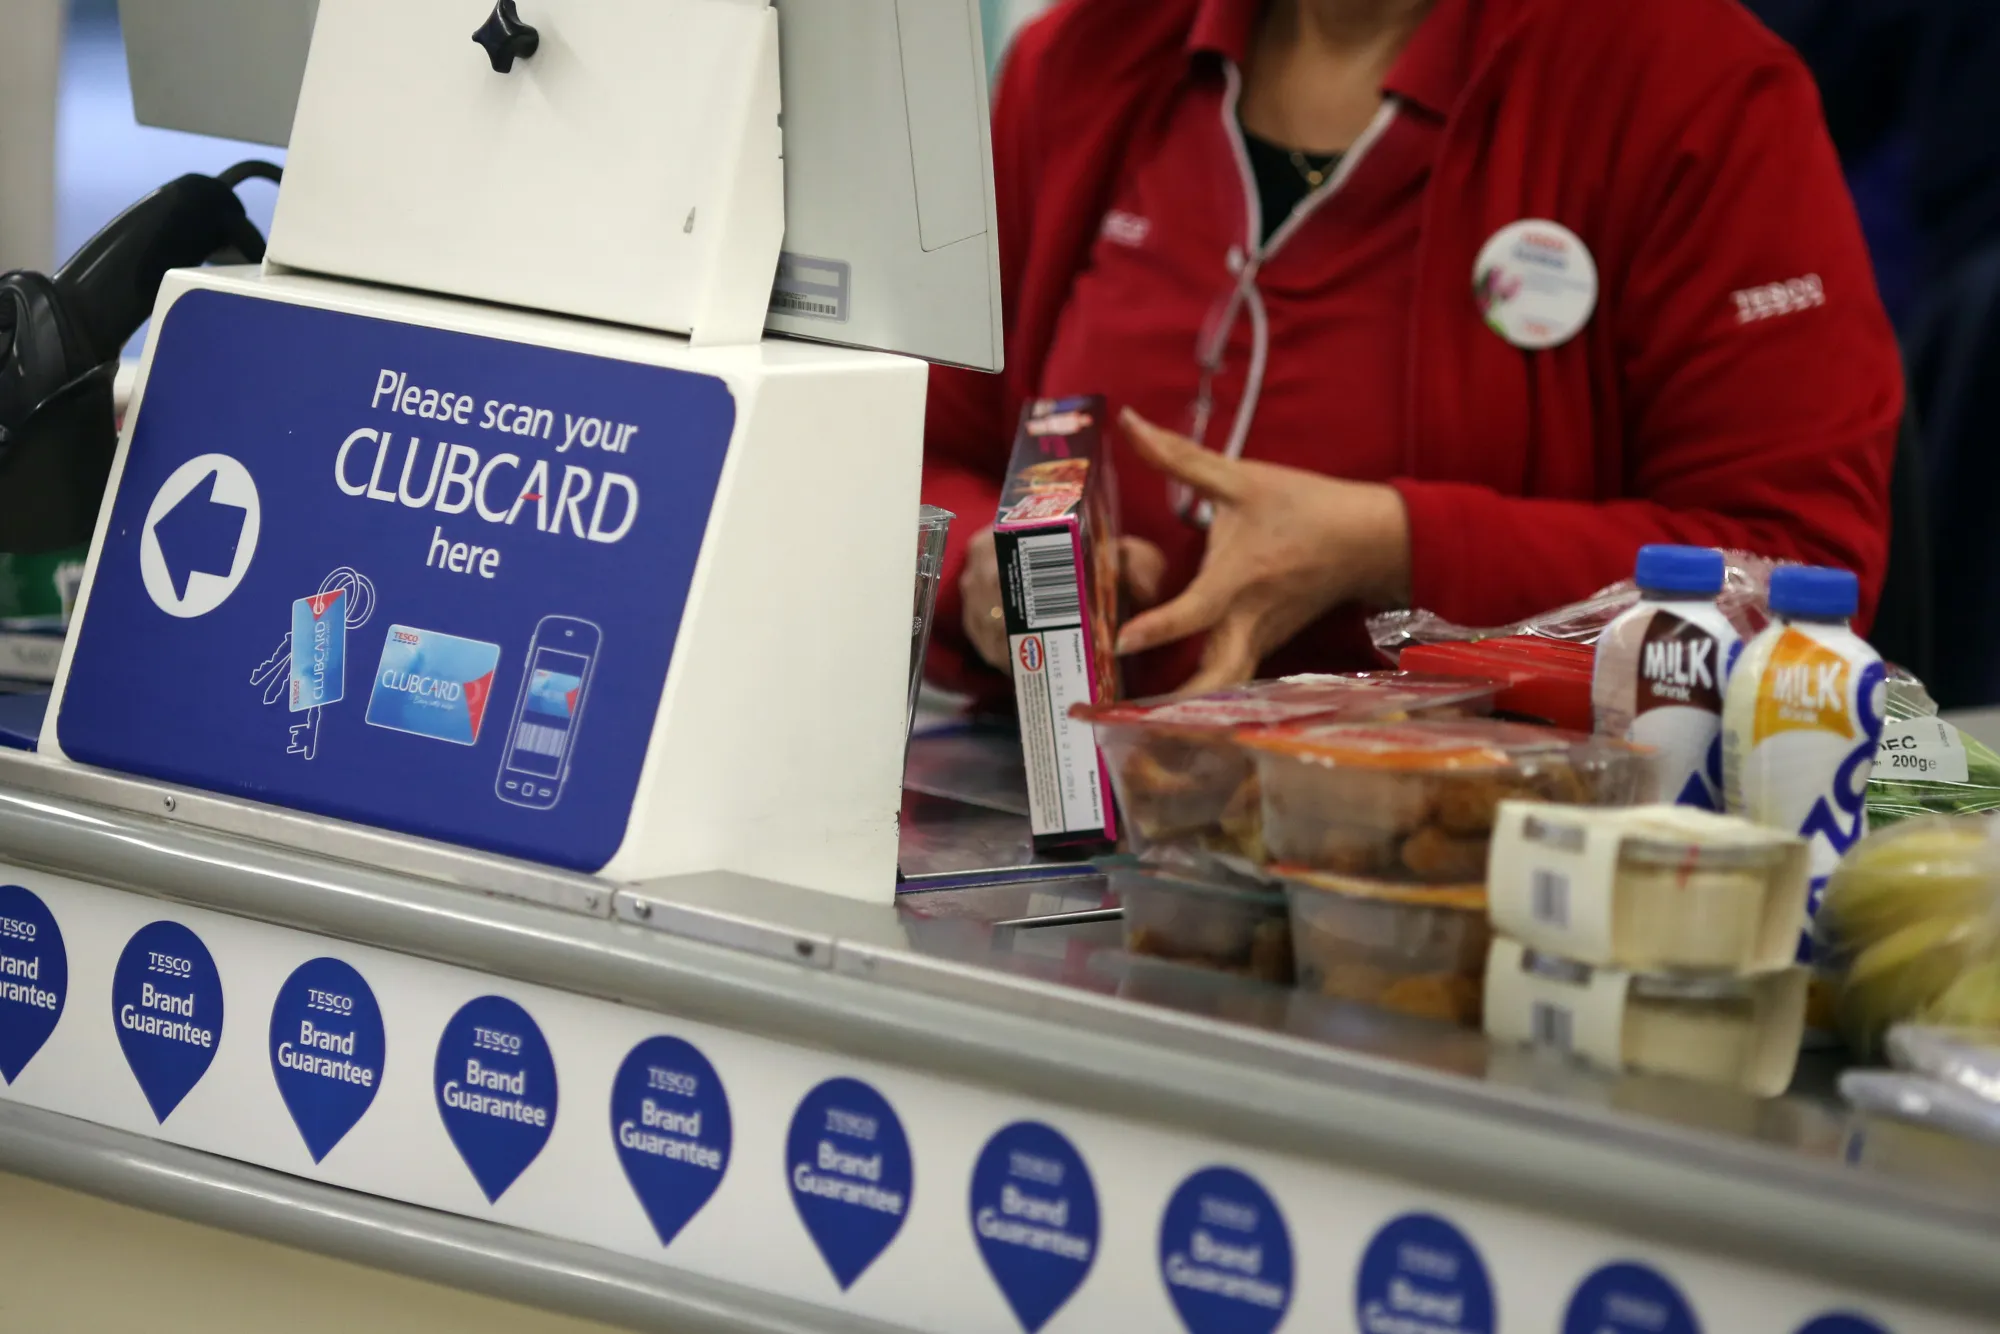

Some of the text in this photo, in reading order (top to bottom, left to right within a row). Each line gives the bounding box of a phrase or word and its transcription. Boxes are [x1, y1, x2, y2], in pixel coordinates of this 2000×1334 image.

[371, 369, 638, 454] Please scan your
[334, 427, 639, 544] CLUBCARD
[426, 525, 500, 579] here
[394, 631, 419, 643] TESCO
[313, 621, 325, 700] CLUBCARD
[382, 669, 460, 702] CLUBCARD
[0, 954, 39, 980] rand
[148, 952, 191, 973] TESCO
[141, 983, 194, 1017] Brand
[308, 989, 352, 1010] TESCO
[120, 1004, 212, 1048] Guarantee
[300, 1020, 354, 1056] Brand
[474, 1027, 521, 1051] TESCO
[278, 1043, 373, 1087] Guarantee
[466, 1059, 524, 1096] Brand
[444, 1081, 547, 1127] Guarantee
[641, 1099, 701, 1137] Brand
[619, 1121, 722, 1171] Guarantee
